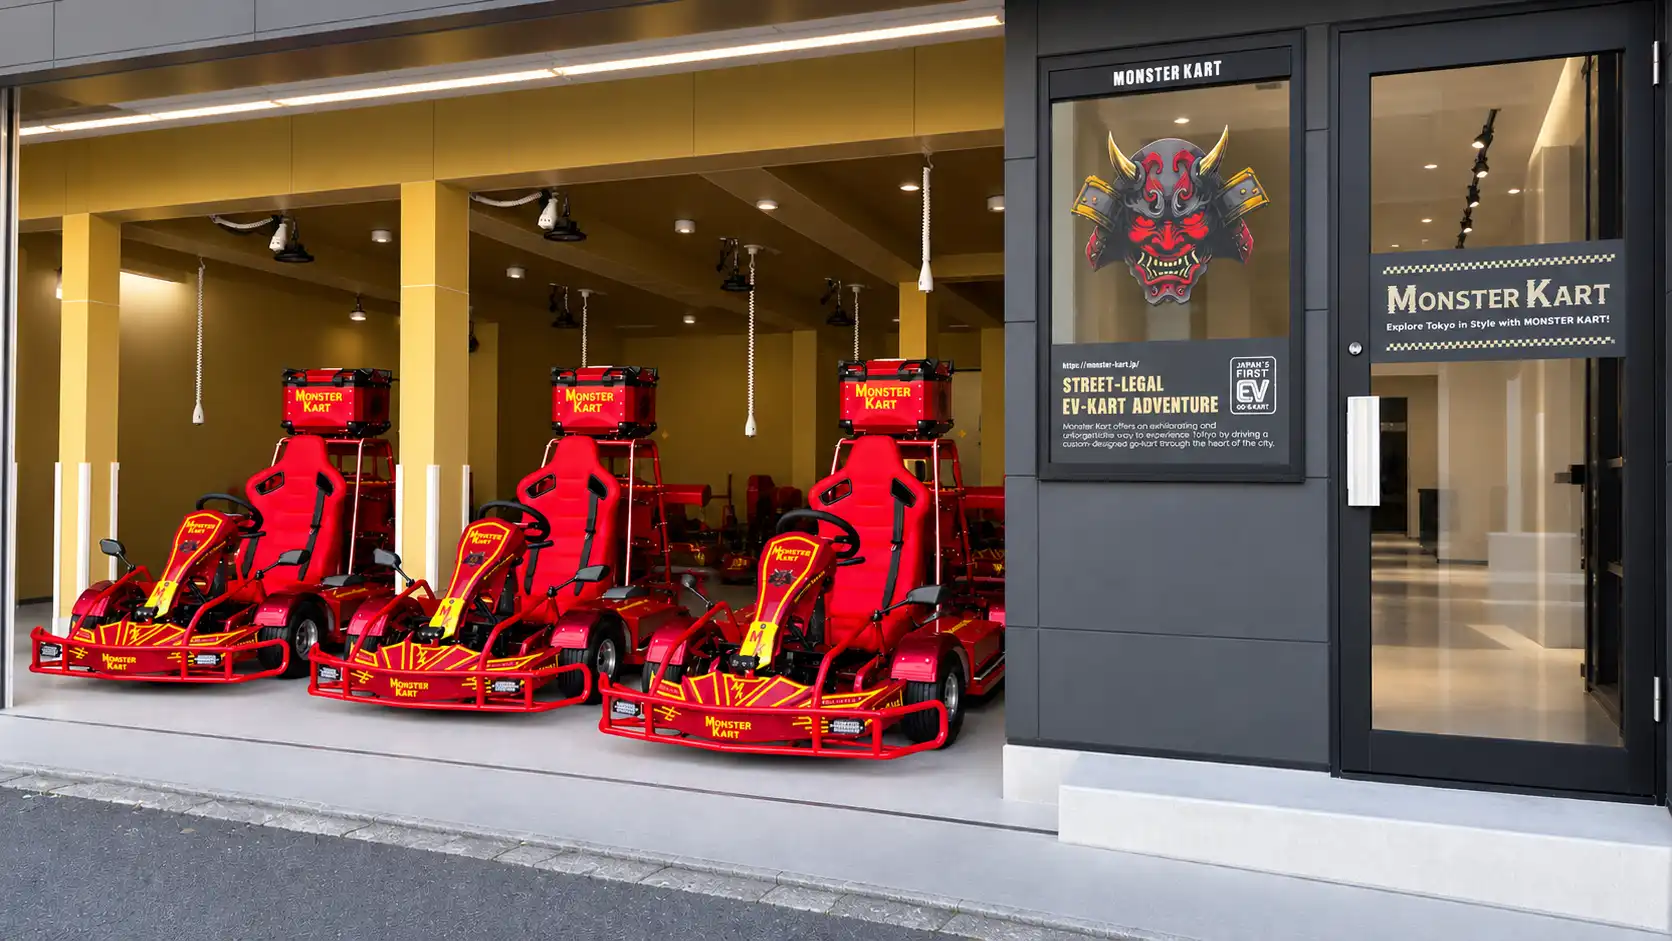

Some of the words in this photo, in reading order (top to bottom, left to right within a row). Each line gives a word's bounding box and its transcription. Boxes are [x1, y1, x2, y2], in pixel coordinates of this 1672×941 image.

[1113, 65, 1180, 86] MONSTER
[1183, 60, 1222, 79] KART
[1387, 284, 1520, 314] MONSTER
[1526, 278, 1611, 308] KART
[1386, 322, 1424, 332] Explore
[1426, 321, 1456, 331] Tokyo
[1458, 320, 1468, 329] in
[1470, 319, 1496, 329] Style
[1498, 318, 1521, 327] with
[1523, 315, 1574, 326] MONSTER
[1576, 314, 1610, 324] KART!
[1236, 369, 1269, 378] FIRST
[855, 383, 911, 397] MONSTER
[1062, 375, 1165, 393] STREET-LEGAL
[1236, 379, 1270, 402] EV
[565, 388, 614, 402] MONSTER
[303, 400, 331, 413] KART
[573, 400, 603, 413] KART
[865, 397, 897, 409] KART
[1062, 397, 1126, 415] EV-KART
[1132, 396, 1219, 414] ADVENTURE
[1112, 422, 1136, 430] offers
[1218, 430, 1230, 439] by
[1231, 430, 1261, 439] driving
[1258, 439, 1275, 448] city.
